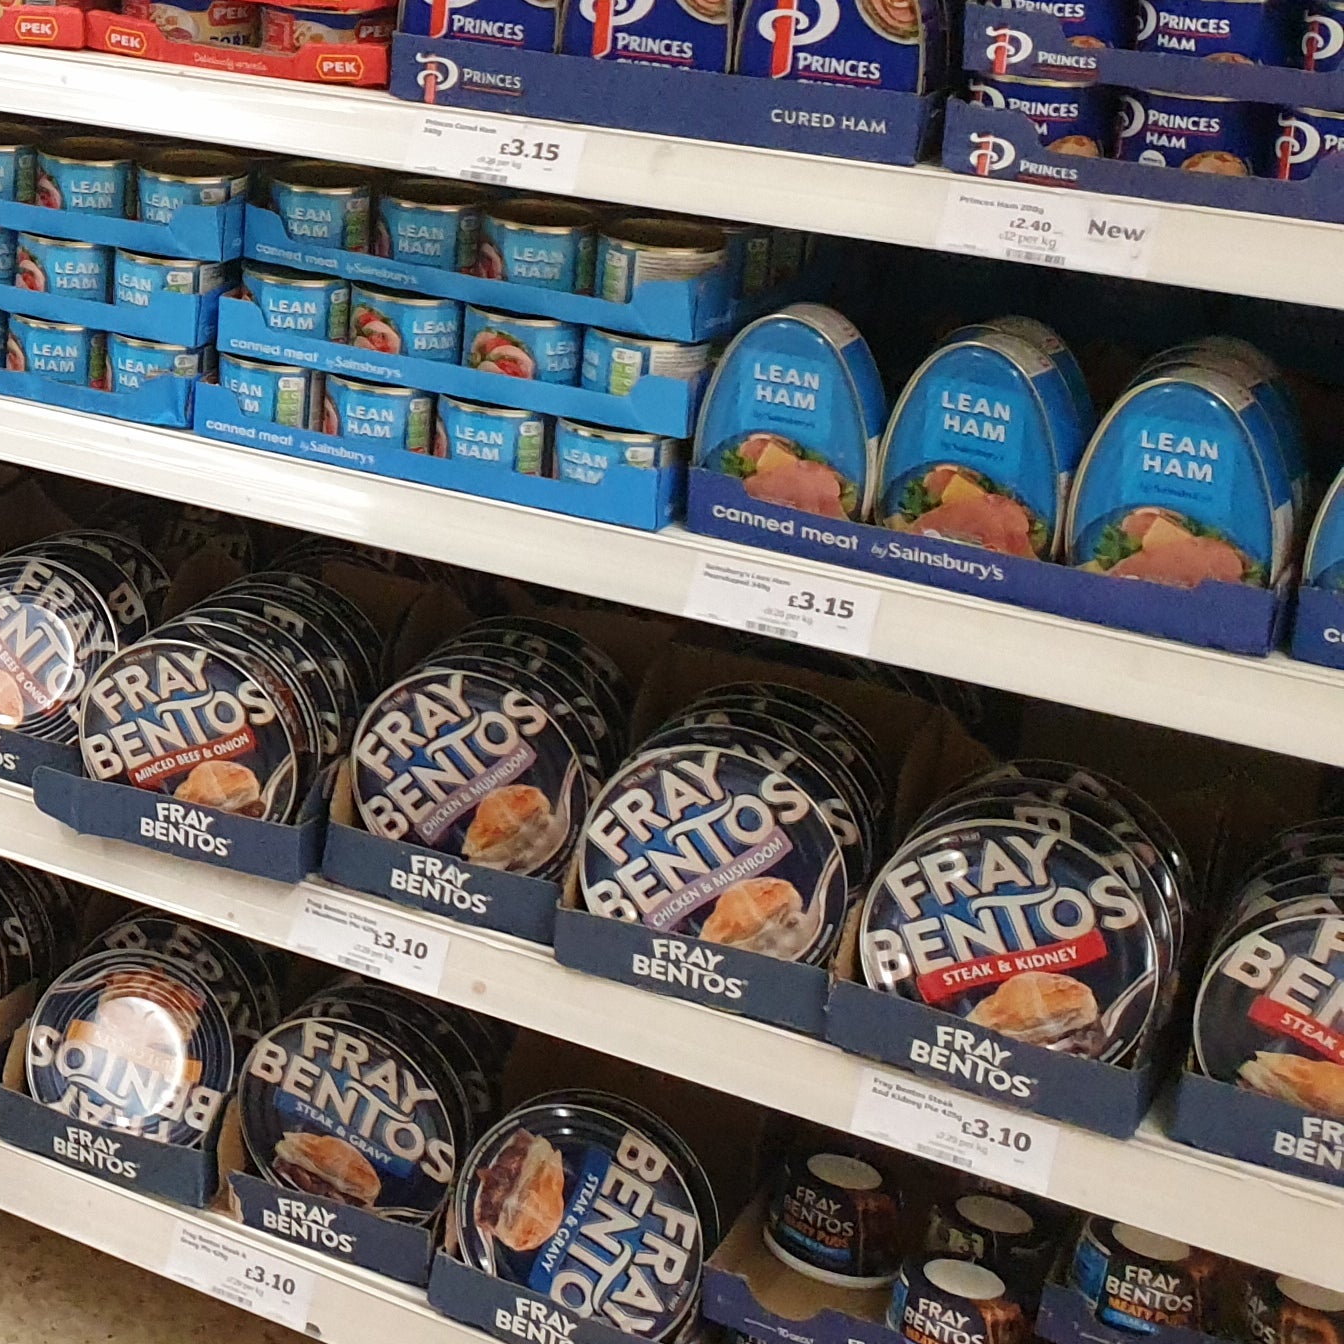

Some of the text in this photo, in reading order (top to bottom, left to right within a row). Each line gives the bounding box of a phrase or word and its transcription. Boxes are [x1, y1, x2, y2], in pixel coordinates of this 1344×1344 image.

[453, 15, 525, 41] PRINCES
[617, 32, 694, 59] PRINCES
[322, 60, 358, 75] PEK
[770, 109, 887, 135] CURED HAM
[500, 138, 560, 161] £3.15
[1010, 218, 1052, 233] £2.40
[1018, 234, 1038, 244] per
[1042, 238, 1057, 248] kg
[1087, 218, 1145, 242] New
[754, 363, 821, 391] LEAN
[754, 384, 817, 411] HAM
[942, 390, 1011, 422] LEAN
[206, 417, 255, 439] canned
[258, 429, 293, 447] meat
[309, 439, 375, 465] Sainsbury's
[943, 413, 1007, 443] HAM
[1140, 429, 1219, 460] LEAN
[1143, 452, 1213, 483] HAM
[712, 503, 1005, 582] canned meat by Sainsbury's
[788, 591, 855, 619] £3.15
[82, 678, 275, 781] BENTOS
[359, 673, 474, 780] FRAY
[135, 759, 175, 785] MINCED
[176, 750, 202, 770] BEEF
[213, 733, 249, 756] ONION
[653, 883, 702, 928] CHICKEN
[713, 838, 783, 891] MUSHROOM
[883, 833, 1058, 919] FRAY
[865, 874, 1140, 993] BENTOS
[652, 938, 725, 972] FRAY
[943, 946, 1078, 987] STEAK & KIDNEY
[632, 954, 742, 999] BENTOS
[1279, 1011, 1338, 1052] STEAK
[295, 1102, 334, 1130] STEAK
[350, 1133, 392, 1164] GRAVY
[962, 1118, 1031, 1152] £3.10
[262, 1210, 352, 1252] BENTOS
[245, 1264, 296, 1296] £3.10
